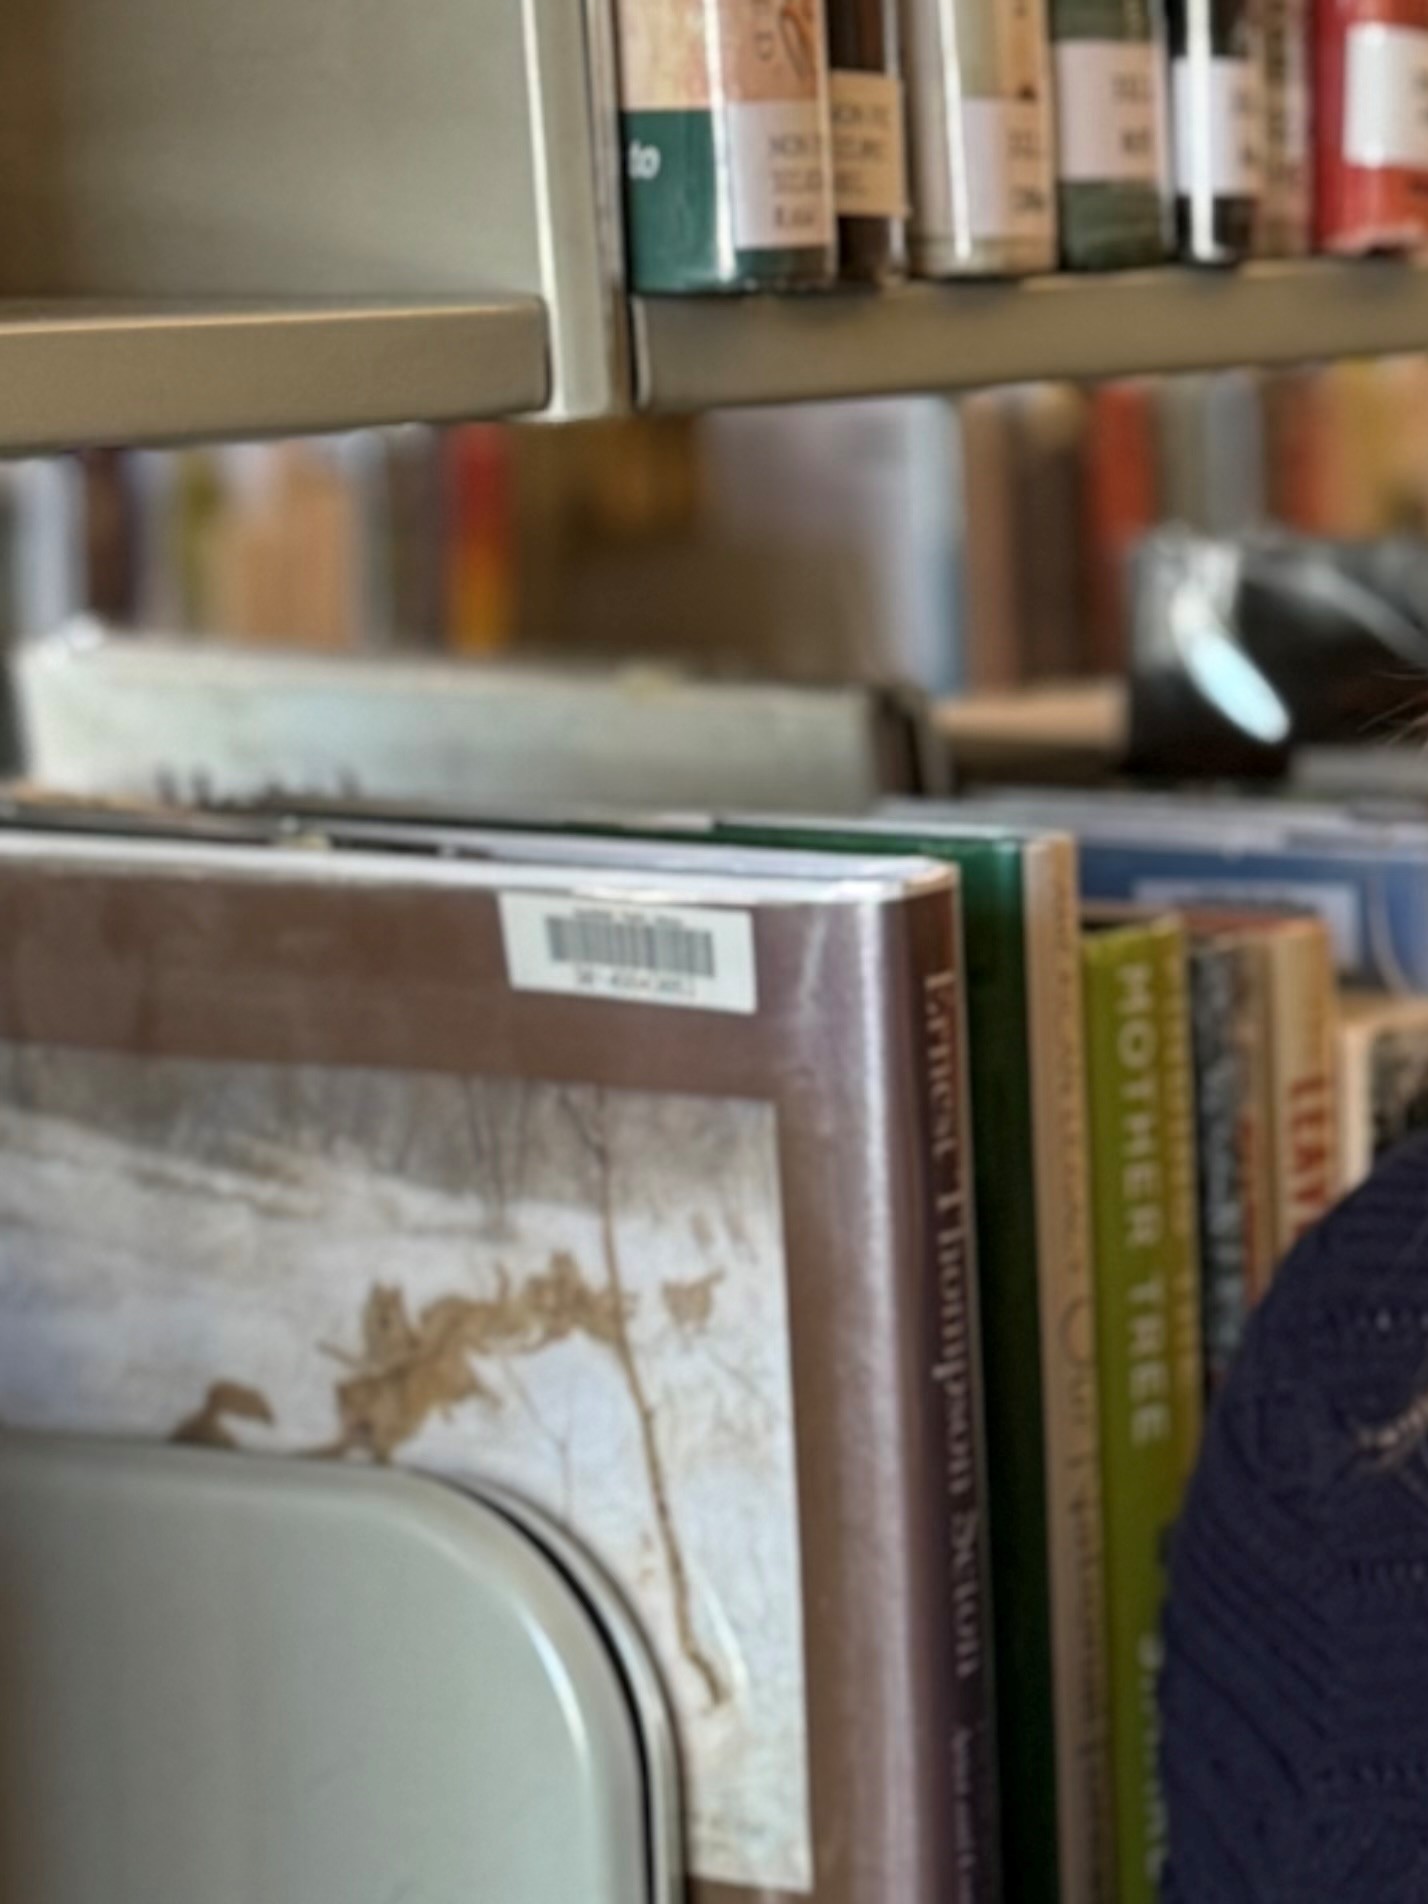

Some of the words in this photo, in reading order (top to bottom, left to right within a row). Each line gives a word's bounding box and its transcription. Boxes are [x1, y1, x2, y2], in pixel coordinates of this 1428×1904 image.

[626, 141, 662, 180] to
[923, 968, 961, 1161] Ernest
[1114, 962, 1164, 1250] MOTHER
[929, 1177, 977, 1497] Thompson
[1126, 1276, 1171, 1448] TREE
[948, 1507, 982, 1680] Seton
